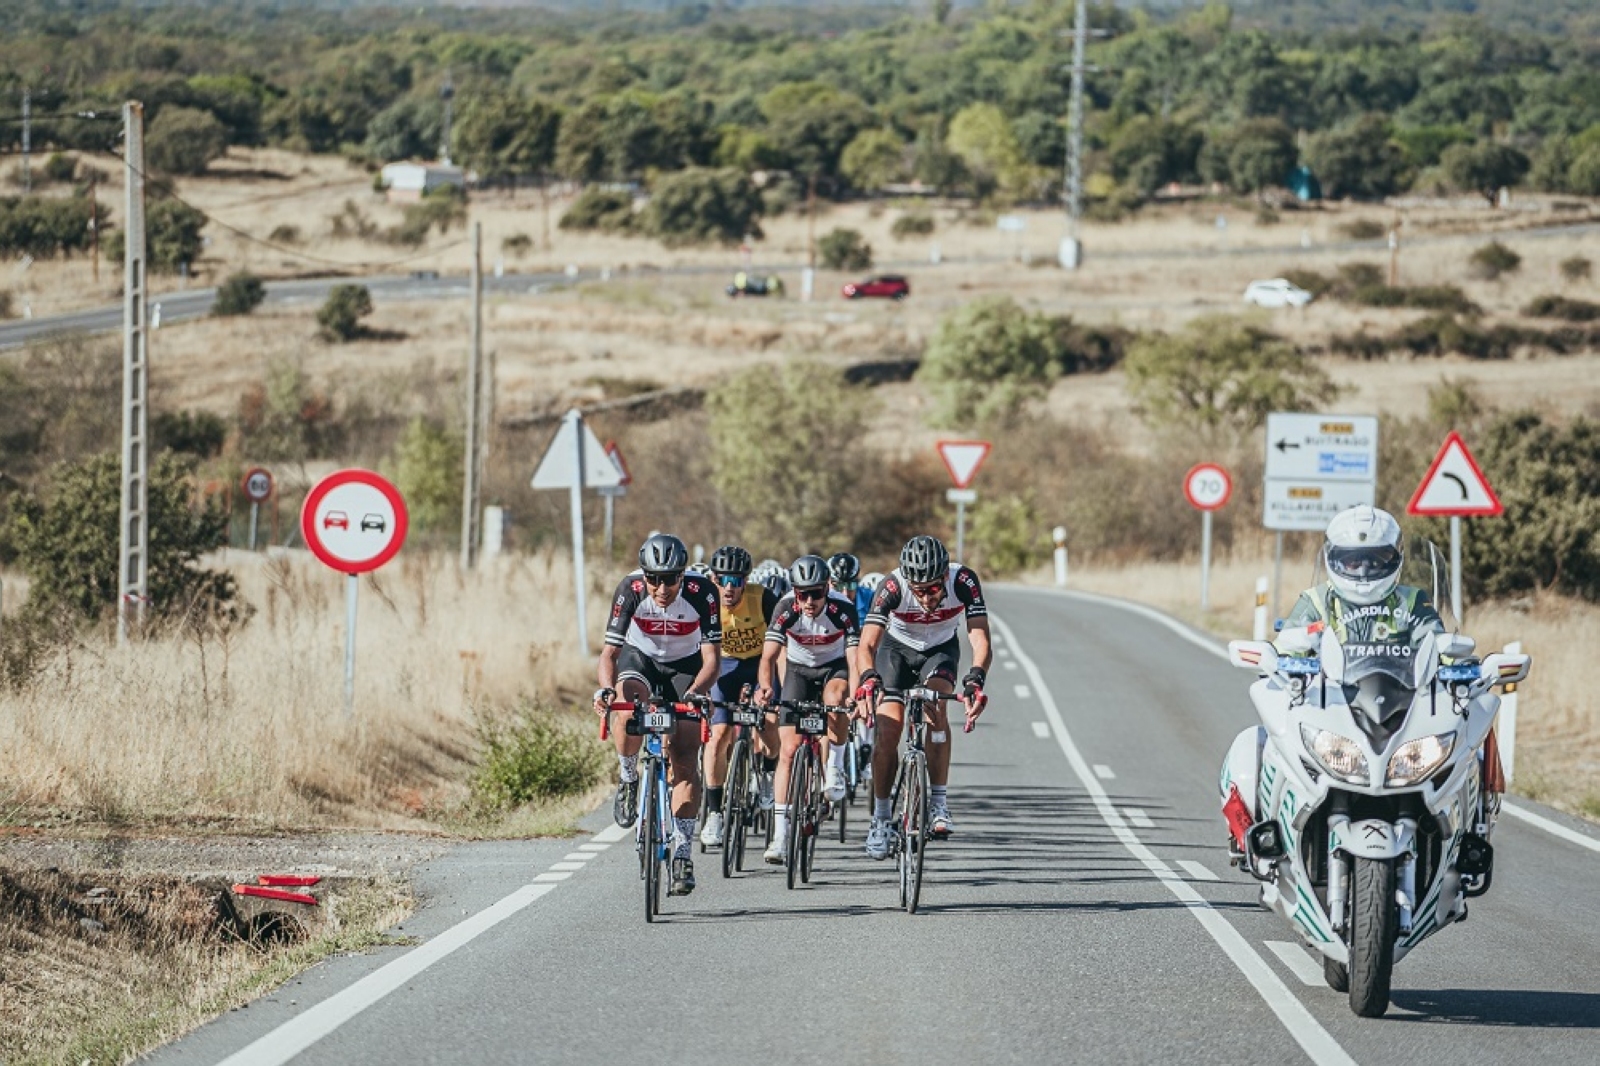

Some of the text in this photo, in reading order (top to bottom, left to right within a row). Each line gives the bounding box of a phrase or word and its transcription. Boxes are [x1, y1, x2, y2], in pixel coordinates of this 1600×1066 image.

[1199, 479, 1220, 494] 70
[1393, 608, 1420, 626] CIVI
[1349, 645, 1411, 657] TRAFICO
[651, 714, 664, 727] 80
